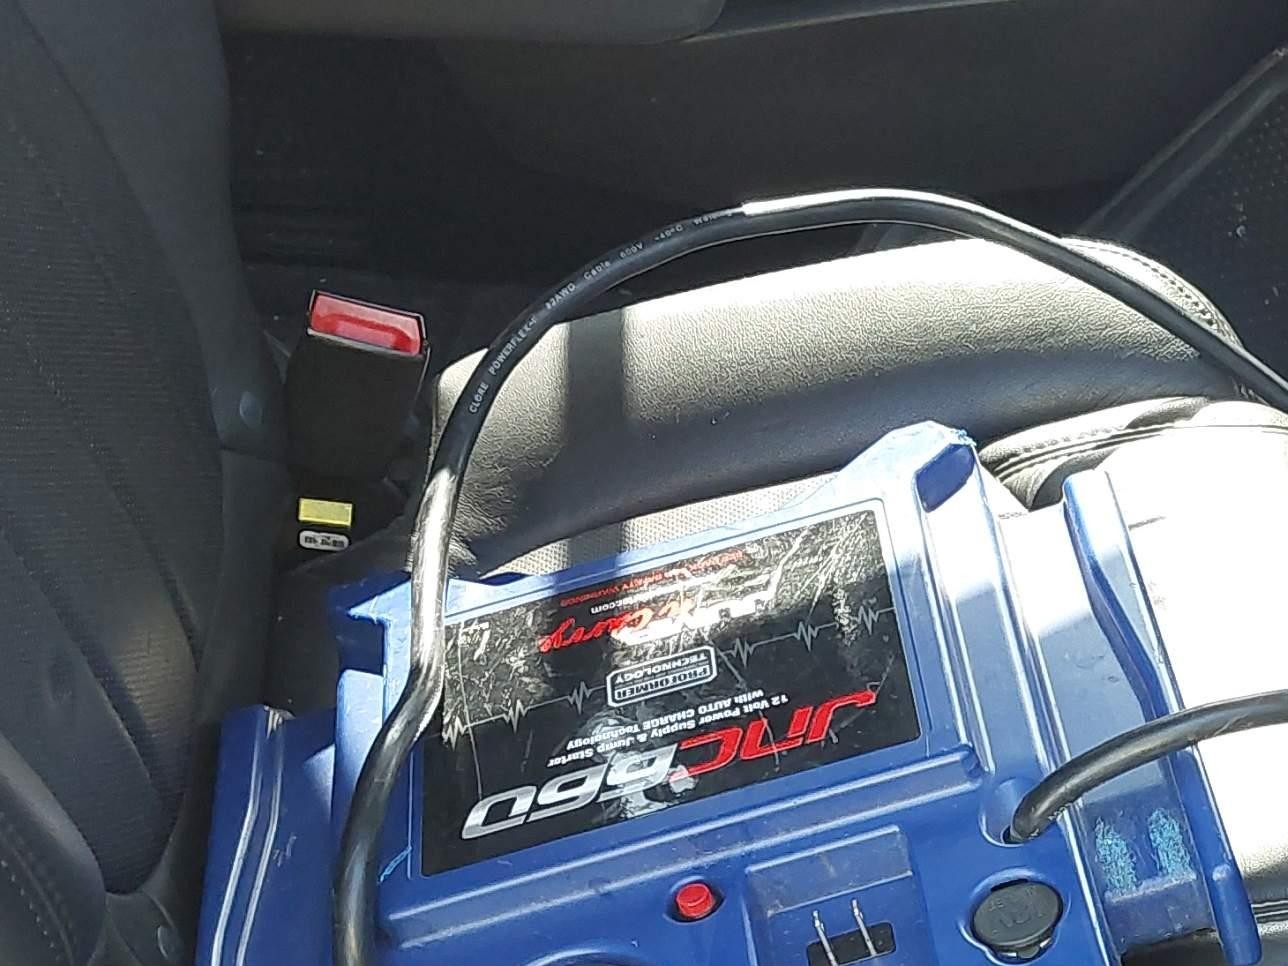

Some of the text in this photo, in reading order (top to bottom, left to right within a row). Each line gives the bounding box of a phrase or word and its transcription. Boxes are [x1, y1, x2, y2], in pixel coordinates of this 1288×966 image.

[468, 382, 489, 413] CLORE
[583, 260, 611, 281] Cable
[614, 650, 707, 684] TECHNOLOGY
[614, 668, 708, 700] PROFORMER
[547, 693, 789, 767] 12 Volt Power Supply & Jump Starter
[566, 689, 764, 750] with AUTO CHARGE Technology
